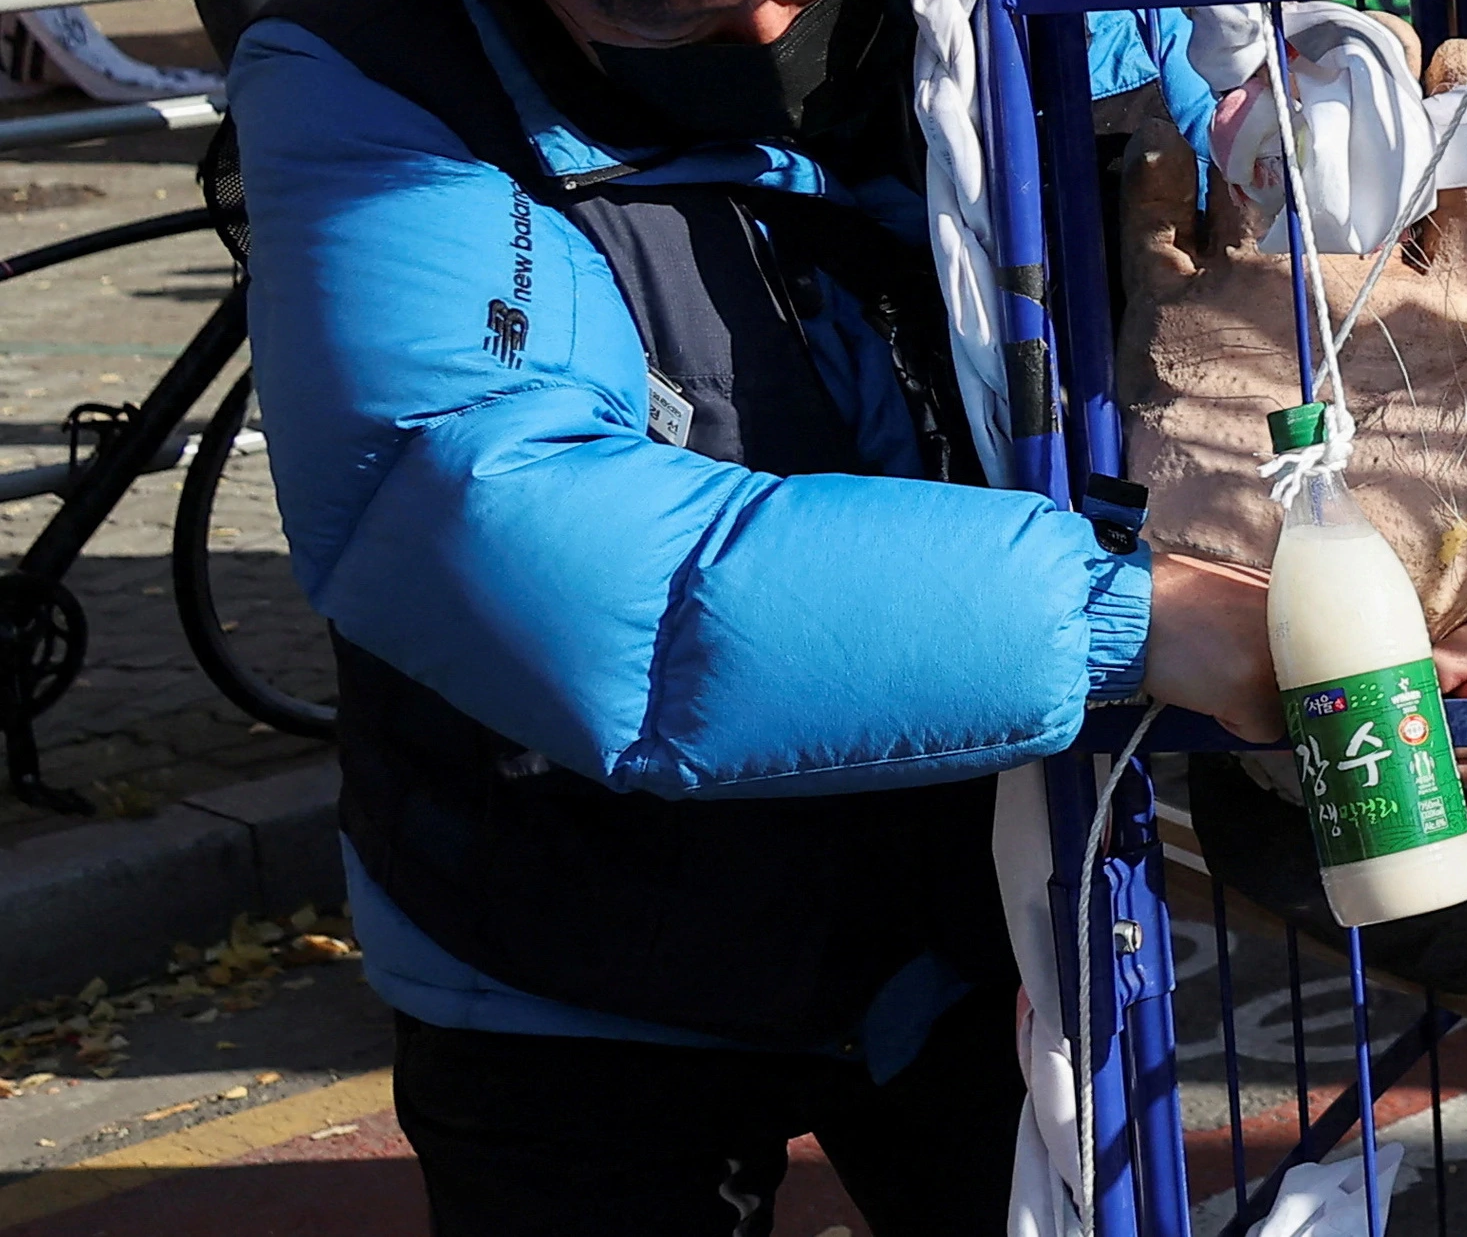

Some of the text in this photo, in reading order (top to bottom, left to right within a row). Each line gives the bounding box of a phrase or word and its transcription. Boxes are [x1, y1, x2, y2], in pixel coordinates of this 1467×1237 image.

[510, 181, 533, 252] balanc
[513, 252, 533, 303] new
[1304, 693, 1335, 715] 서울
[1295, 720, 1393, 797] 장수
